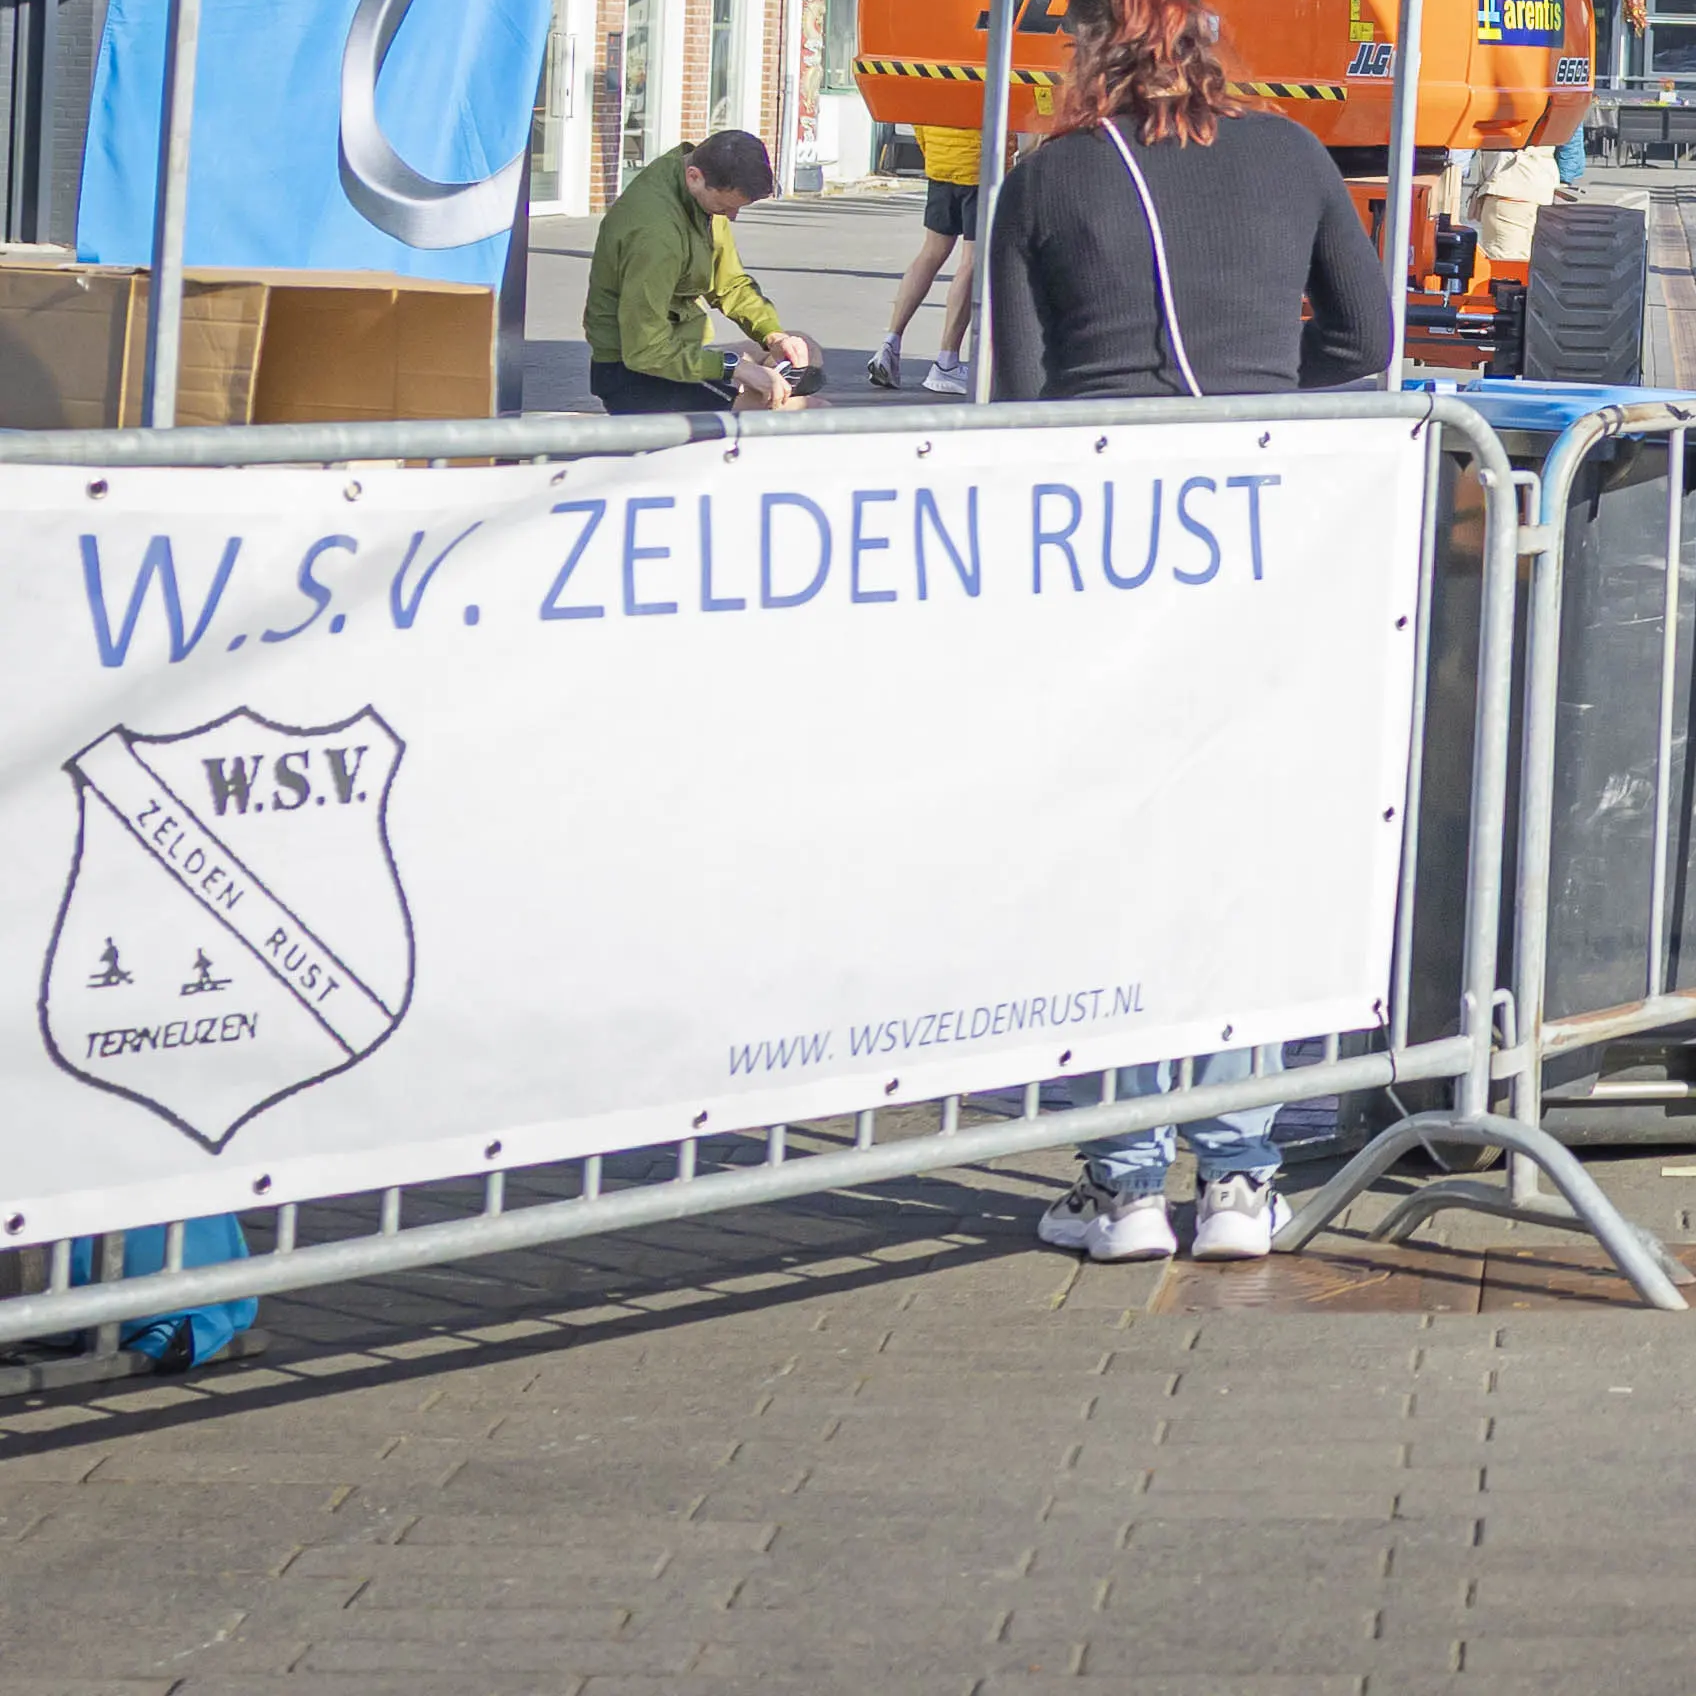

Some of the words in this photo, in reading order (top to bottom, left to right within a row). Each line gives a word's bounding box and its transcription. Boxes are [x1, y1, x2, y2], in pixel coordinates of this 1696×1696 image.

[77, 518, 485, 668] W.S.V.
[538, 485, 983, 622] ZELDEN
[1029, 473, 1284, 596] RUST
[201, 744, 370, 817] W.S.V.
[134, 798, 245, 911] ZELDEN
[264, 926, 340, 1003] RUST
[86, 1012, 260, 1060] TERNEUZEN
[727, 1039, 836, 1077] WWW.
[848, 983, 1146, 1060] WSVZELDENRUST.NL
